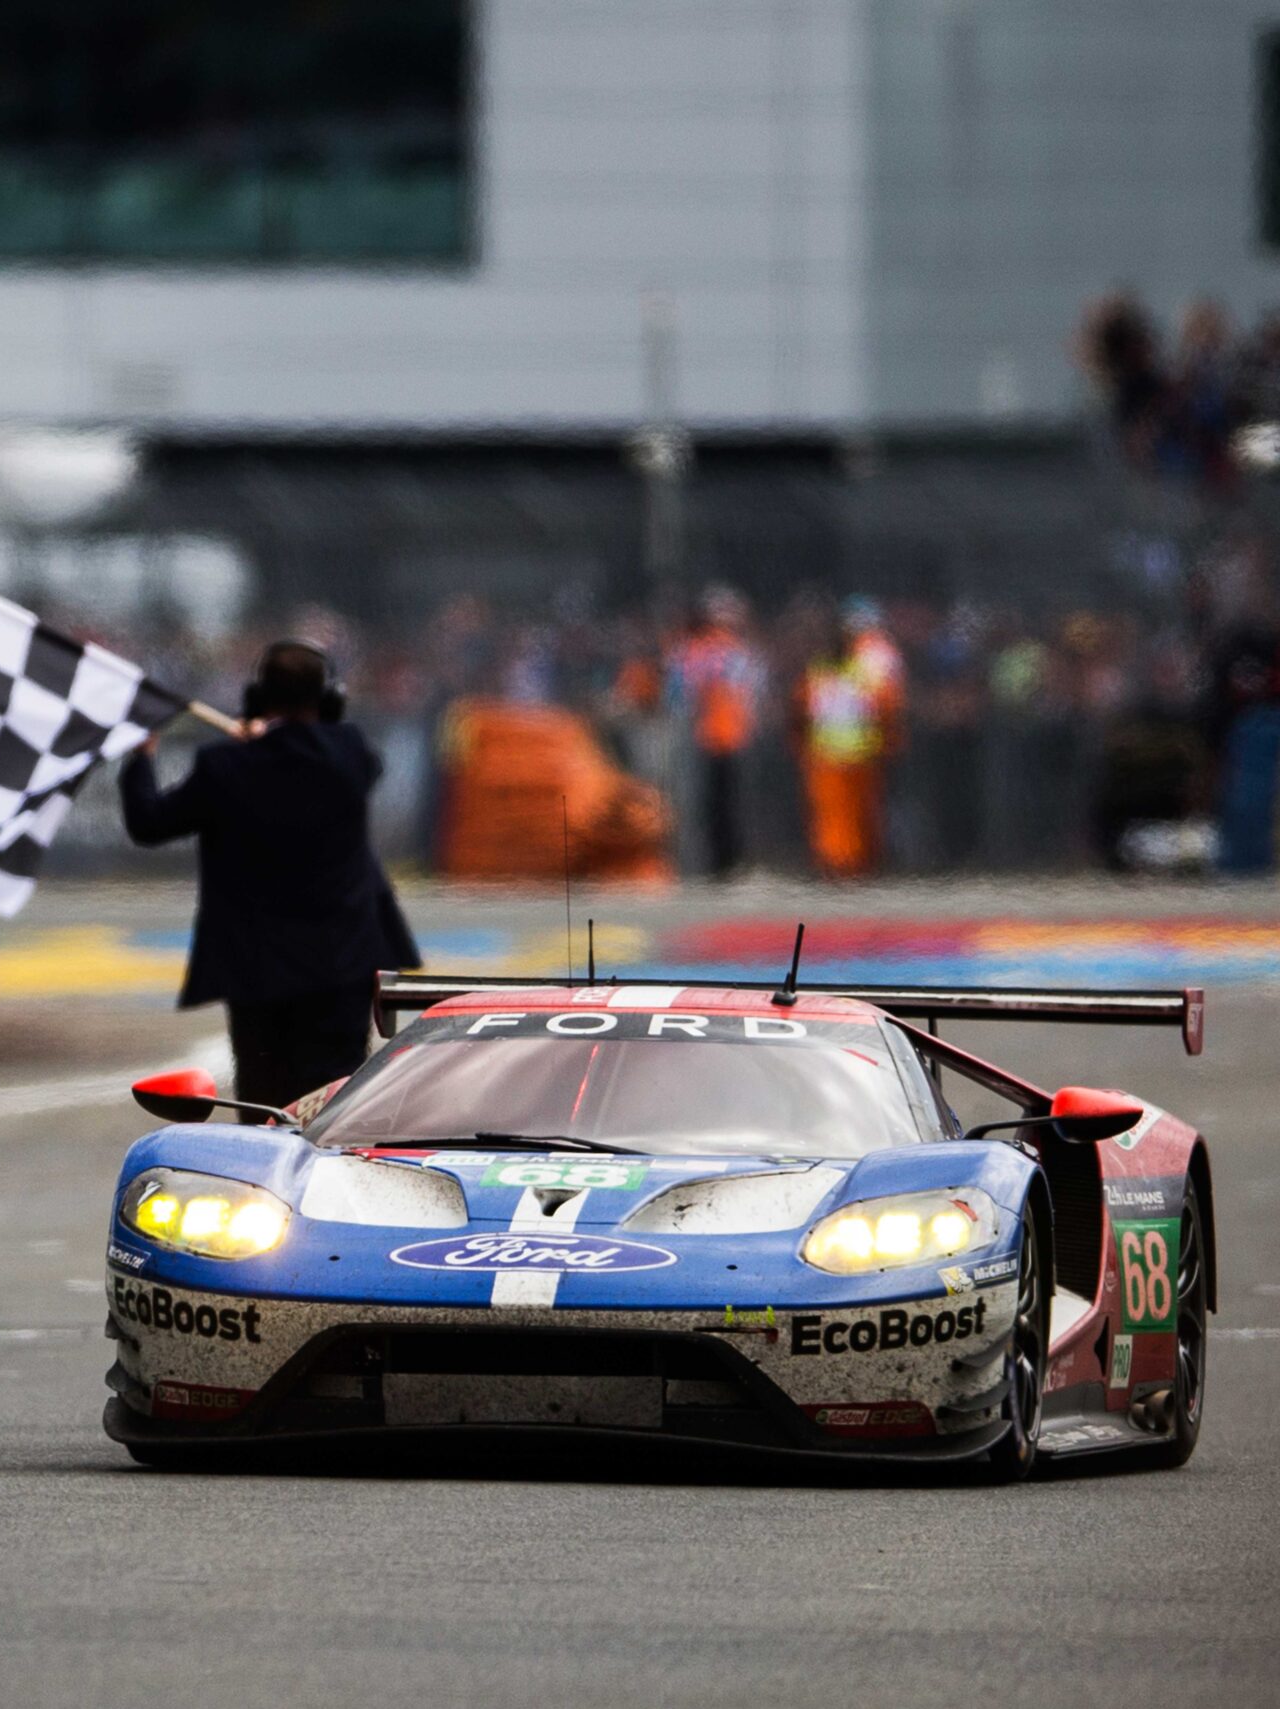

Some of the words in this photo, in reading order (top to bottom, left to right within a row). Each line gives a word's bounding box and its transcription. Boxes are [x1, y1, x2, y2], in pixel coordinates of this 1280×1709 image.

[467, 1012, 807, 1039] FORD
[497, 1164, 628, 1187] 68
[444, 1236, 622, 1267] Ford
[1122, 1231, 1172, 1321] 68
[114, 1275, 261, 1343] EcoBoost
[791, 1297, 987, 1355] EcoBoost
[190, 1390, 240, 1409] EDGE
